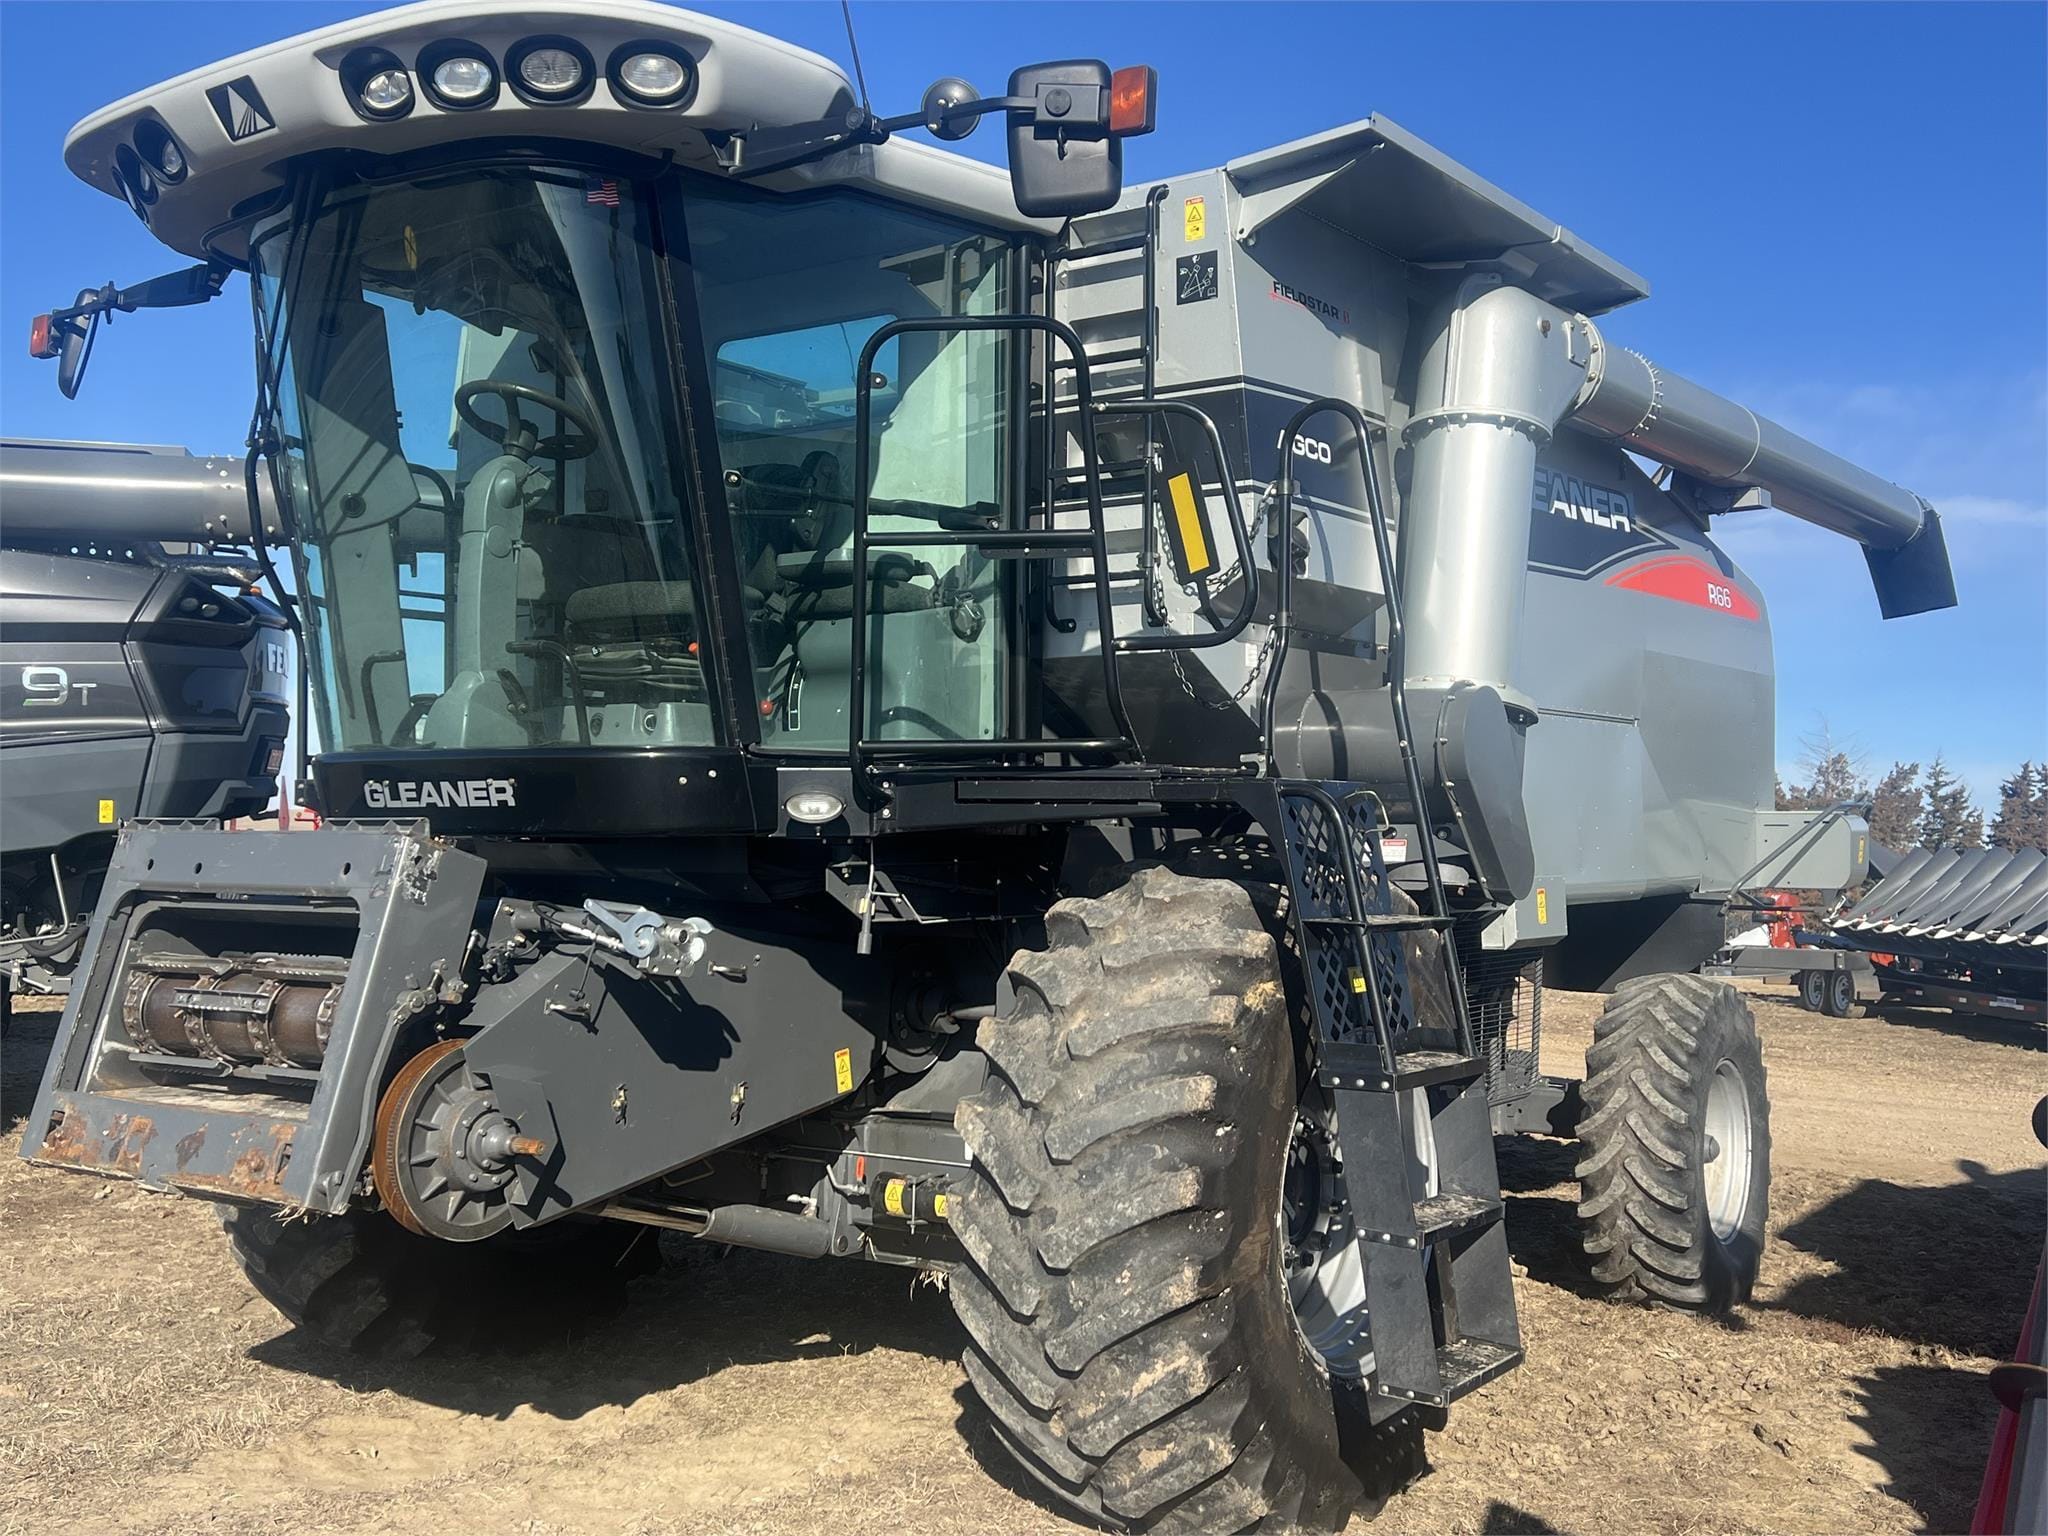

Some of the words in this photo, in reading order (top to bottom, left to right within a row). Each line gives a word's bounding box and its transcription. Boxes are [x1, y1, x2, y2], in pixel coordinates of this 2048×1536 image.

[1272, 280, 1339, 320] FIELDSTAR
[1707, 583, 1732, 609] R66
[363, 779, 516, 808] GLEANER
